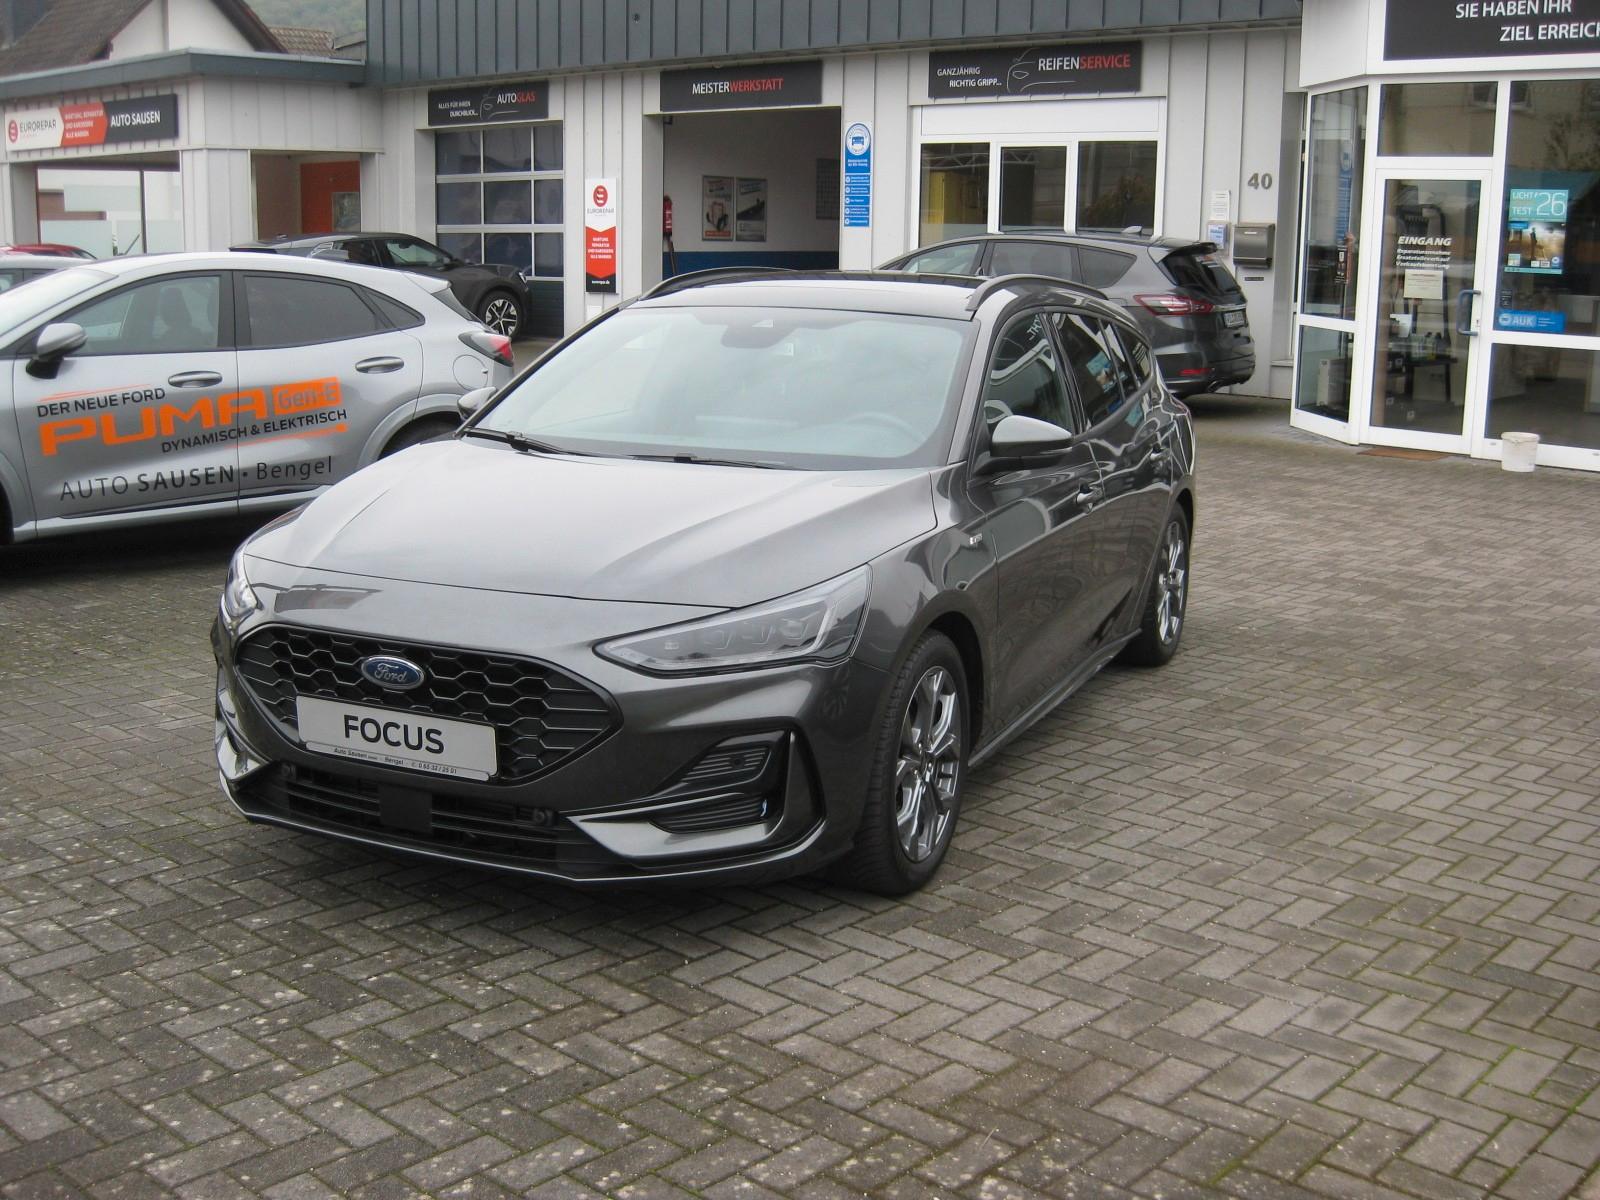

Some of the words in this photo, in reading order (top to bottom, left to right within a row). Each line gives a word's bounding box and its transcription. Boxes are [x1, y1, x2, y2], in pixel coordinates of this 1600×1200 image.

[1455, 3, 1479, 19] SIE
[1482, 0, 1539, 17] HABEN
[1543, 0, 1572, 14] IHR
[1499, 25, 1534, 41] ZIEL
[1038, 54, 1131, 71] REIFENSERVICE
[936, 66, 981, 77] GANZJÄHRIG
[692, 78, 784, 95] MEISTERWERKSTATT
[949, 78, 976, 88] RICHTIG
[497, 91, 536, 104] AUTOGLAS
[19, 119, 57, 133] EUROREPAR
[110, 115, 131, 128] AUTO
[131, 111, 161, 126] SAUSEN
[1247, 172, 1273, 190] 40
[1511, 191, 1533, 200] LICHT
[1511, 206, 1532, 216] TEST
[1397, 235, 1452, 247] EINGANG
[37, 400, 70, 418] DER
[74, 394, 119, 413] NEUE
[122, 387, 166, 404] FORD
[37, 388, 269, 457] PUMA
[277, 380, 338, 408] Gen-E
[161, 425, 248, 454] DYNAMISCH
[249, 423, 261, 436] &
[263, 408, 347, 433] ELEKTRISCH
[60, 475, 129, 501] AUTO
[137, 464, 235, 492] SAUSEN
[256, 455, 333, 482] Bengel
[373, 662, 409, 684] Ford
[343, 714, 445, 754] FOCUS
